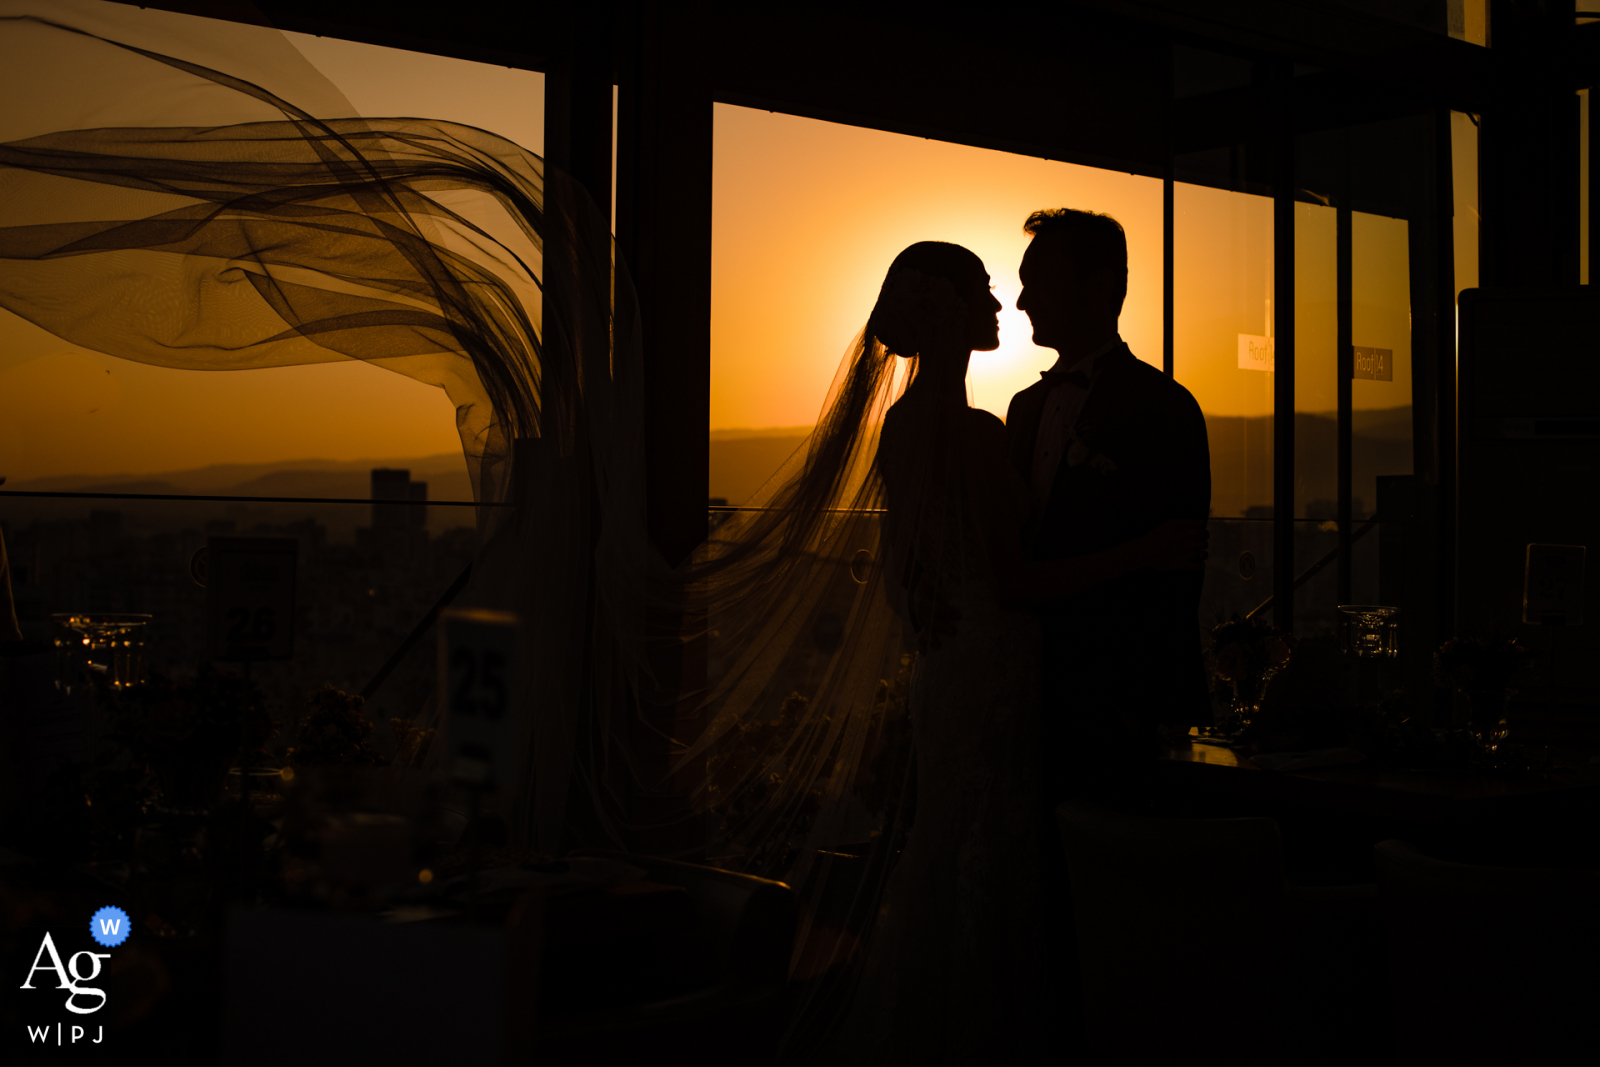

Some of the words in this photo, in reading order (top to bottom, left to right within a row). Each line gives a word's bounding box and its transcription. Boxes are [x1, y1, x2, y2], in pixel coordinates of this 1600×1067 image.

[1539, 575, 1569, 600] 27
[226, 606, 276, 642] 26
[451, 647, 506, 719] 25
